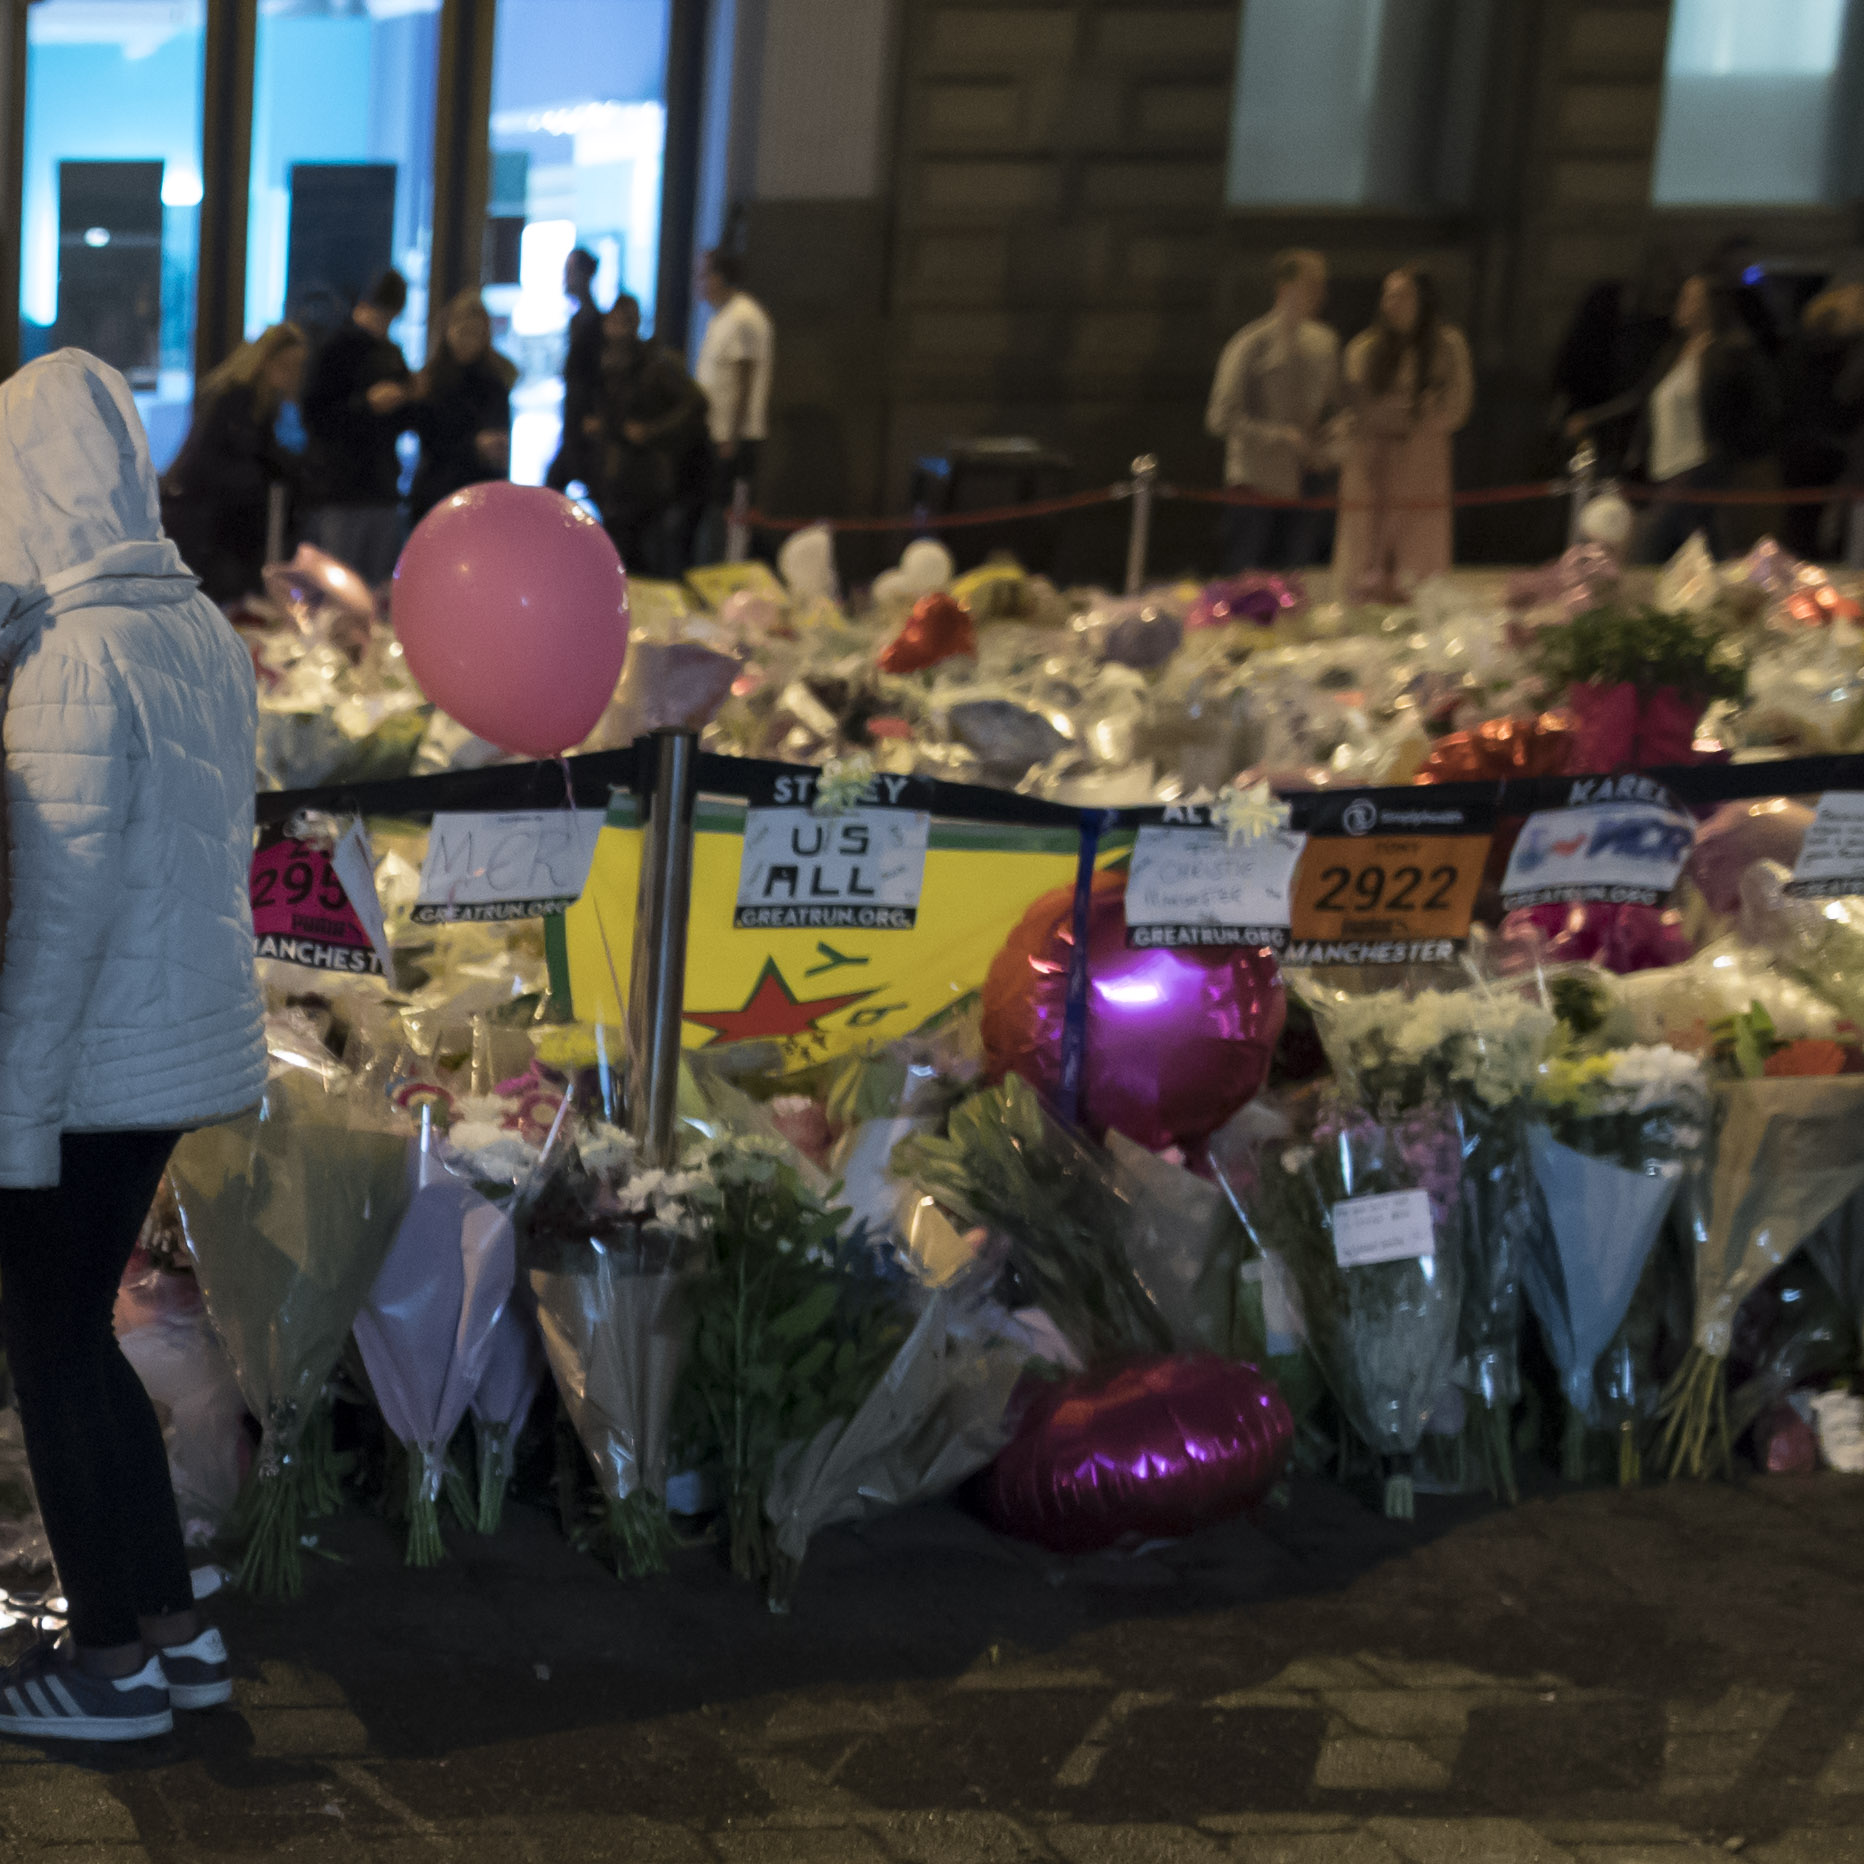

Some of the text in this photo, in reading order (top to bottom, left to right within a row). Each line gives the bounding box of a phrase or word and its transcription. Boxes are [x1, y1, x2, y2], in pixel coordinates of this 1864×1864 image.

[773, 774, 909, 804] STEY
[791, 825, 870, 856] US
[762, 865, 875, 897] ALL
[1314, 865, 1459, 912] 2922
[740, 905, 908, 928] GREATRUN.ORG
[1284, 939, 1456, 964] MANCHESTER
